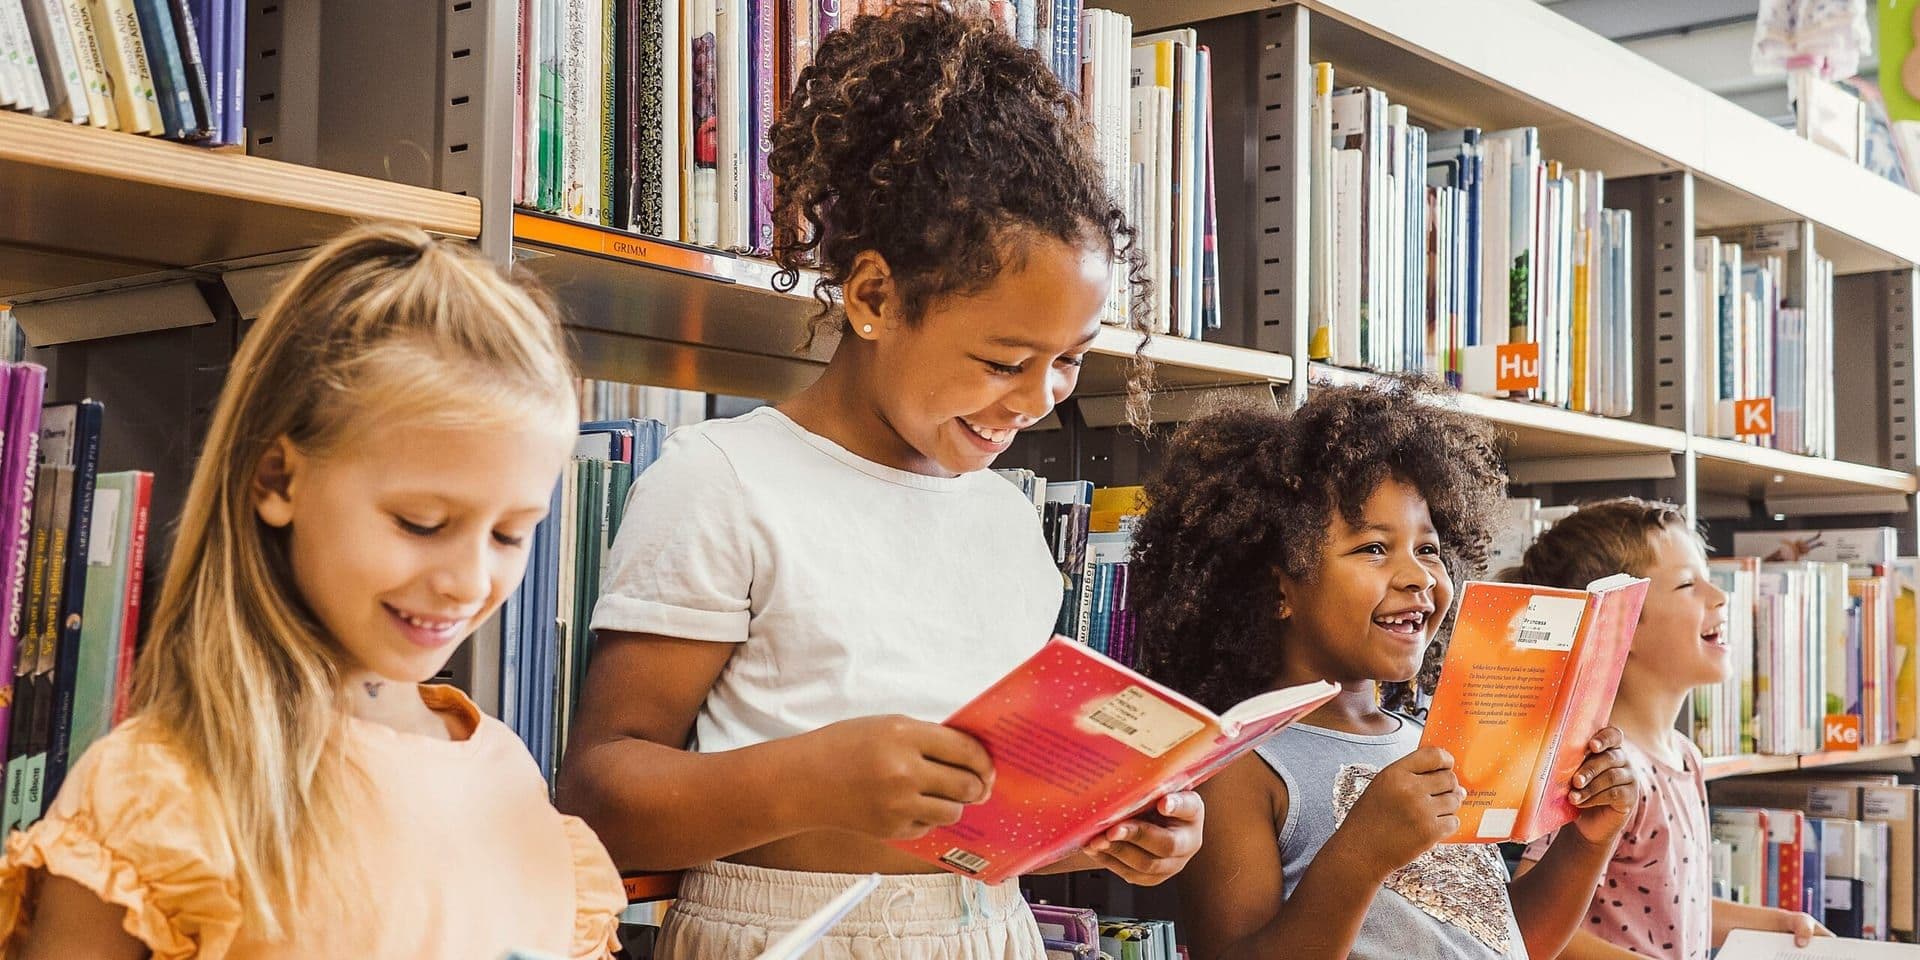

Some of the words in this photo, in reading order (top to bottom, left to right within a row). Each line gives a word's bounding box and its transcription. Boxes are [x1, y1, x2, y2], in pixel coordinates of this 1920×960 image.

[602, 72, 611, 110] Grimm
[602, 113, 610, 156] Wilhelm
[602, 168, 610, 199] Jacob
[613, 241, 647, 257] GRIMM
[1501, 357, 1539, 379] Hu
[1743, 404, 1768, 431] K
[21, 432, 39, 503] MINUTA
[18, 506, 31, 535] ZA
[8, 538, 28, 636] PRAVLJICO
[1082, 563, 1096, 606] Bogdan
[1079, 611, 1089, 643] Grom
[1826, 723, 1857, 745] Ke
[11, 769, 21, 805] Gibson
[30, 768, 40, 803] Gibson
